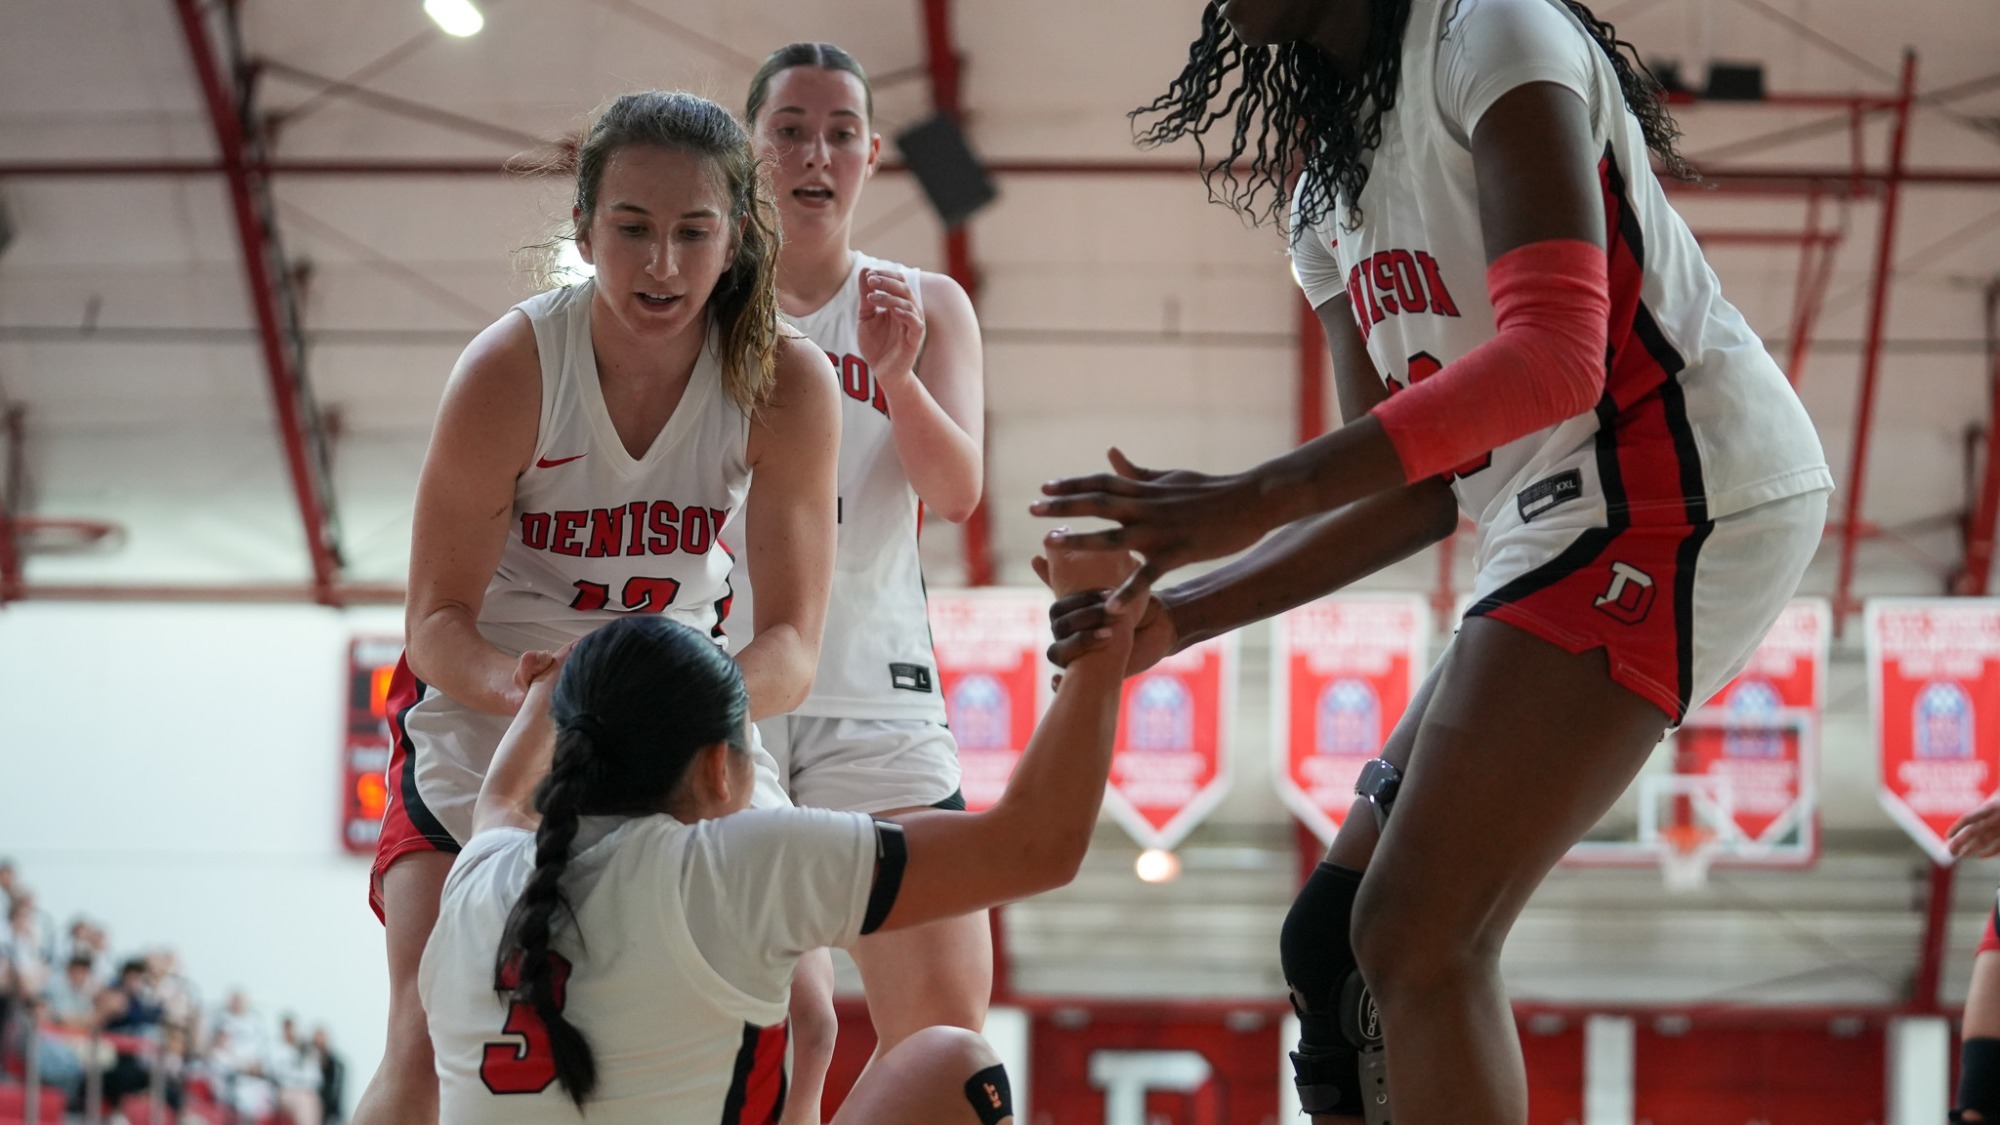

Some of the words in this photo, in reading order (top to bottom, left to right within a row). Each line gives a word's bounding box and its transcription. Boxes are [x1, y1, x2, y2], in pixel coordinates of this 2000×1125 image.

[1556, 479, 1577, 493] XXL
[1593, 560, 1658, 626] D
[919, 672, 927, 685] L
[479, 947, 574, 1096] 3
